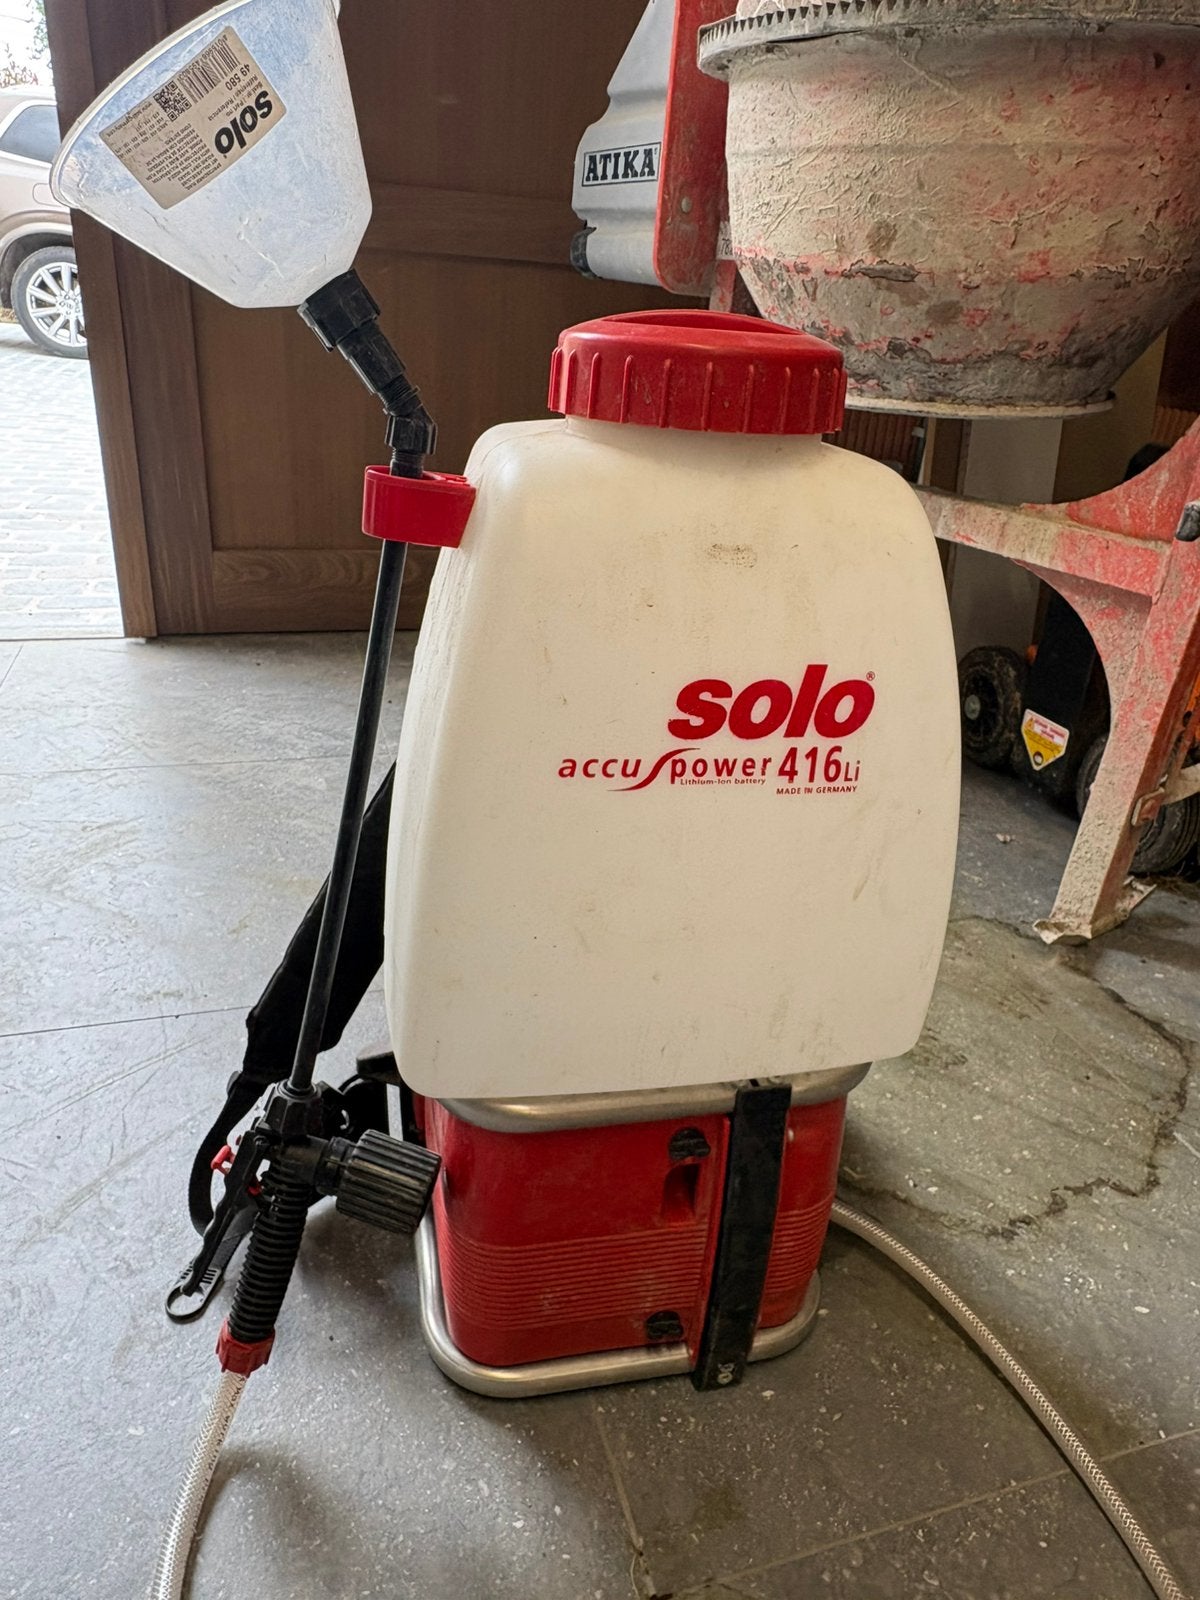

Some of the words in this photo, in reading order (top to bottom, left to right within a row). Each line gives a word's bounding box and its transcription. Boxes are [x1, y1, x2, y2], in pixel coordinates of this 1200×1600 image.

[238, 62, 252, 77] 49
[223, 72, 242, 91] 580
[215, 90, 272, 154] solo
[585, 148, 656, 182] ATIKA
[667, 664, 875, 740] solo
[558, 758, 642, 778] accu
[670, 757, 772, 784] power
[734, 778, 766, 786] battery
[776, 787, 801, 795] MADE
[804, 786, 813, 794] IN
[816, 785, 858, 794] GERMANY
